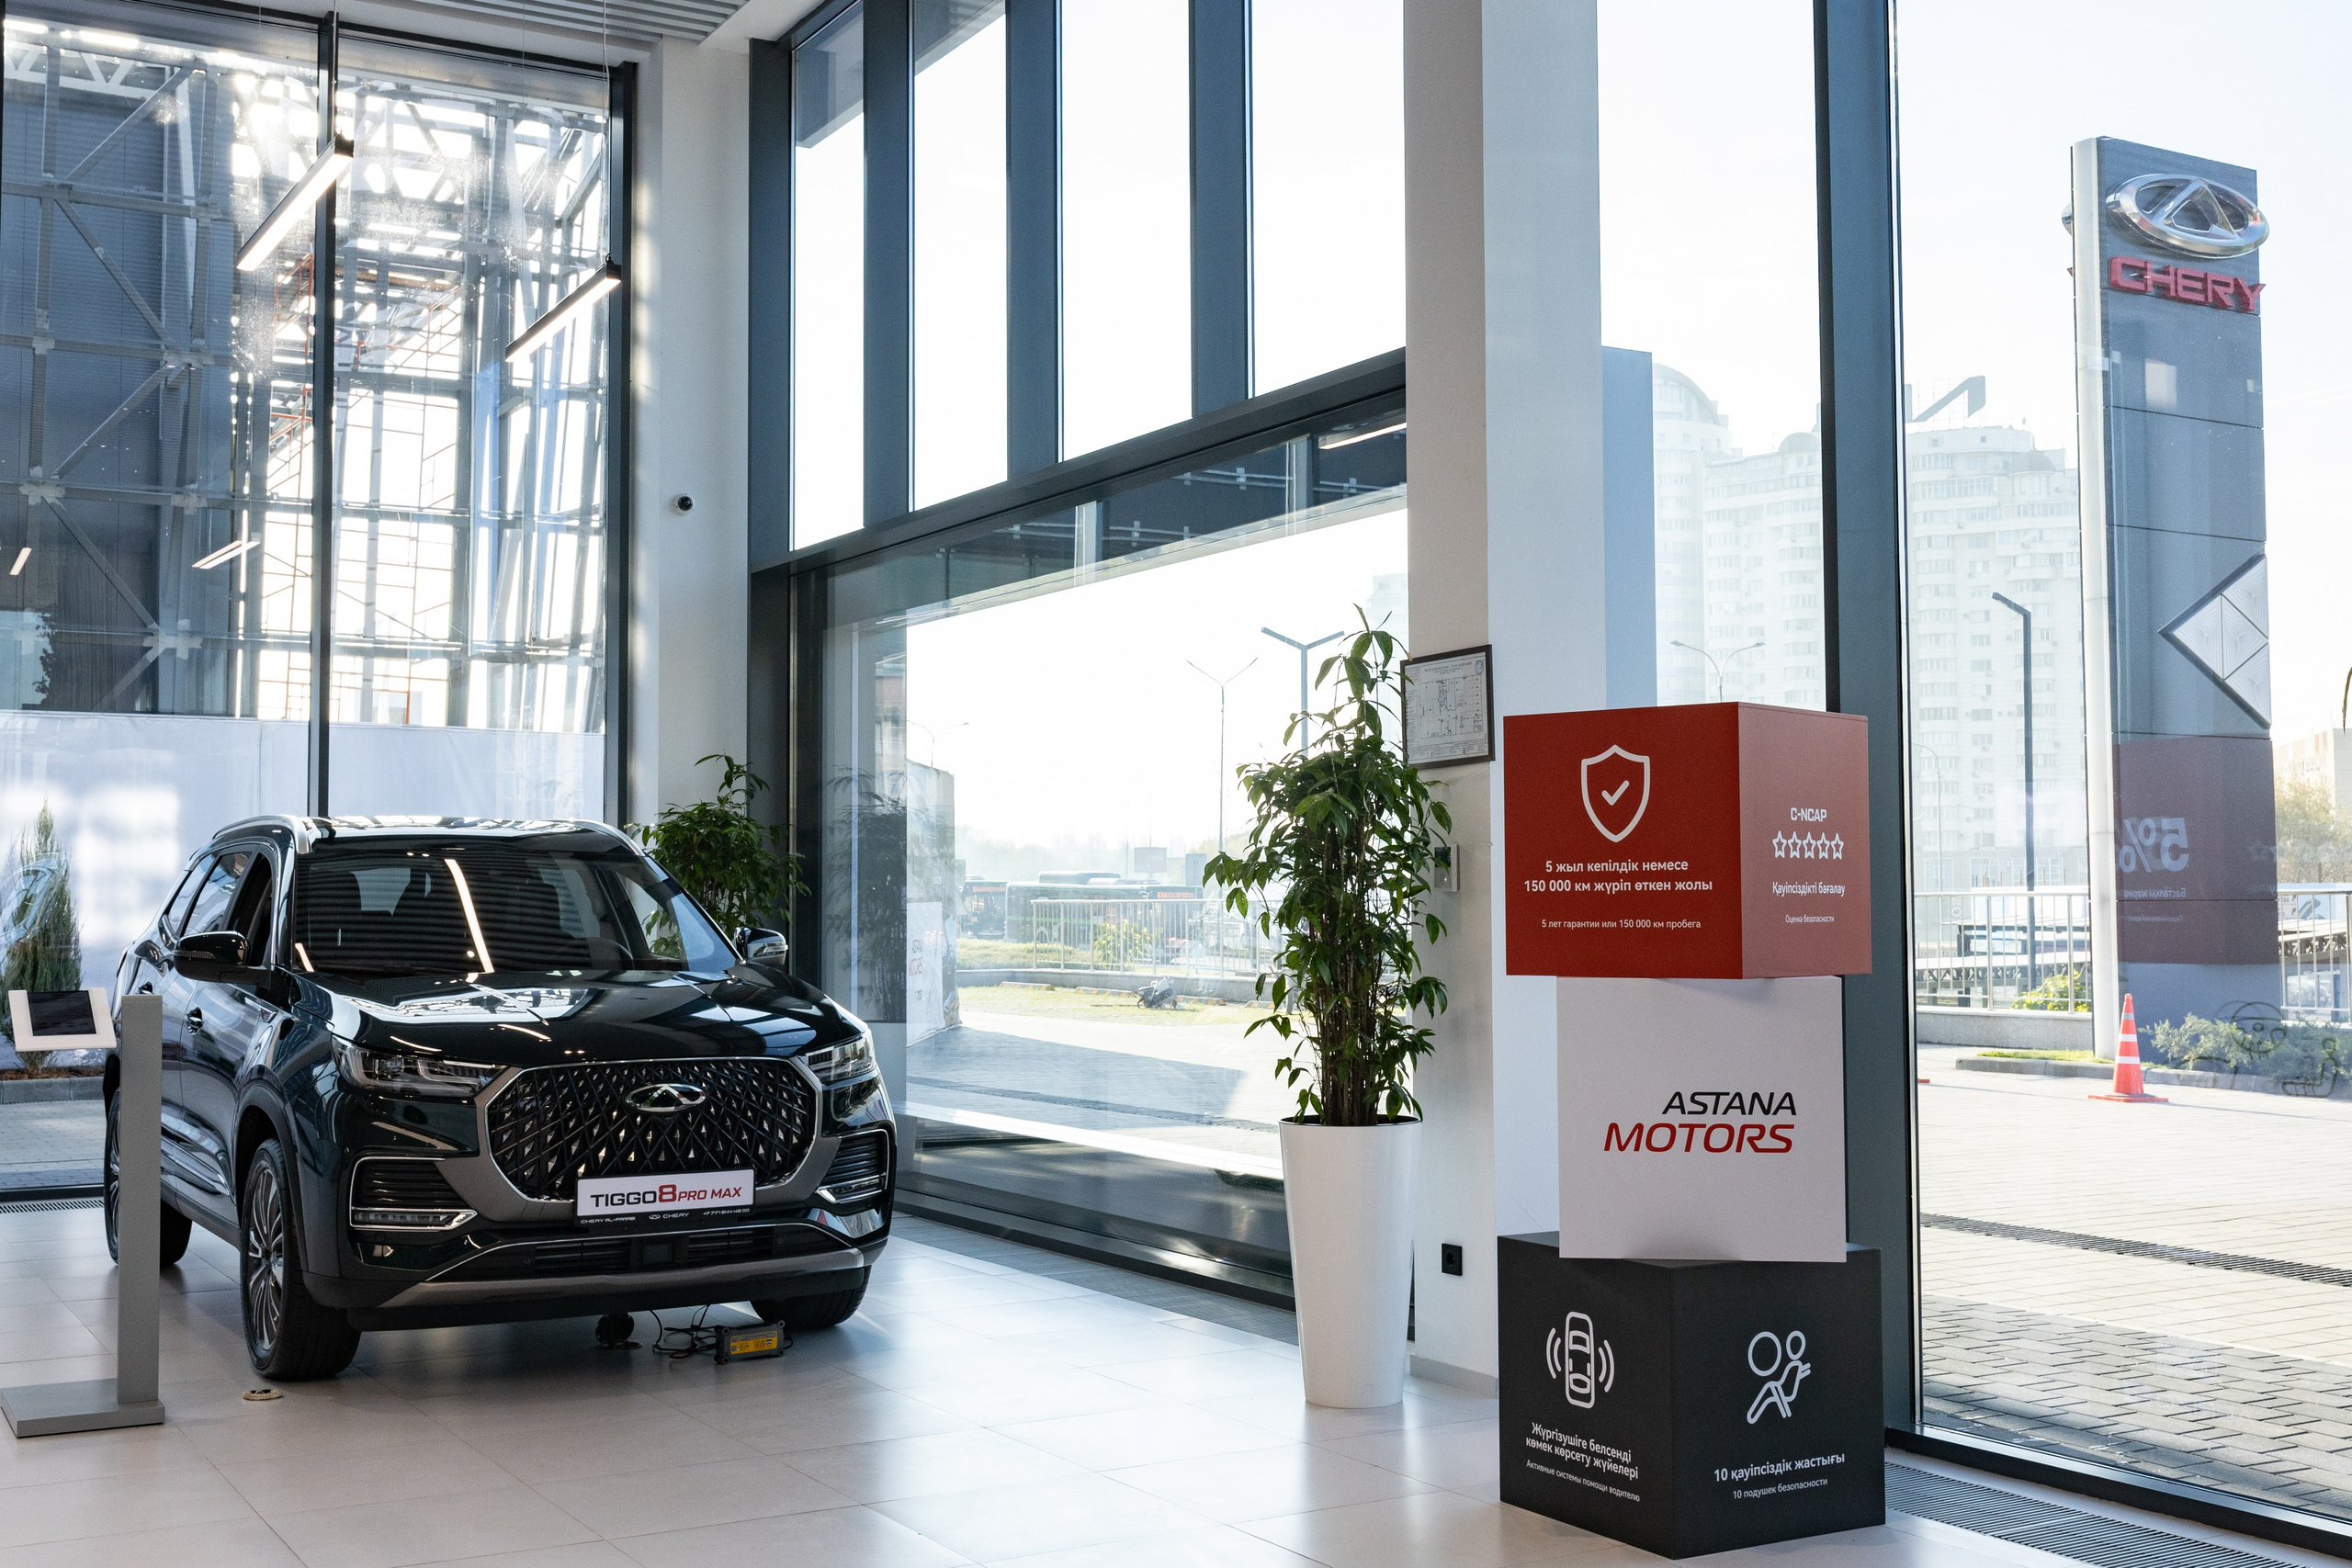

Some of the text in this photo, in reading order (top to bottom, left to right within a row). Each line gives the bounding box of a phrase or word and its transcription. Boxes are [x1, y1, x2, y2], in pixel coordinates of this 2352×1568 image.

[2109, 255, 2267, 312] CHERY
[1790, 807, 1827, 822] C-NCAP
[1545, 859, 1689, 874] 5 жыл кепілдік немесе
[1524, 879, 1713, 895] 150 000 км жүріп өткен жолы
[1772, 882, 1845, 897] Қауіпсіздікті бағалау
[1542, 919, 1547, 928] 5
[1564, 921, 1600, 930] гарантии
[1619, 919, 1634, 928] 150
[1635, 919, 1651, 928] 000
[1667, 919, 1702, 930] пробега
[1785, 914, 1835, 924] Оценка безопасности
[1661, 1091, 1797, 1115] ASTANA
[1604, 1122, 1795, 1154] MOTORS
[678, 1190, 707, 1201] PRO
[710, 1187, 742, 1200] MAX
[1532, 1422, 1632, 1464] Жүргізушіге белсенді
[1525, 1437, 1639, 1481] көмек көрсету жүйелері
[1714, 1453, 1845, 1482] 10 қауіпсіздік жастығы
[1526, 1459, 1641, 1502] Активные системы помощи водителю
[1733, 1478, 1828, 1499] 10 подушек безопасности
